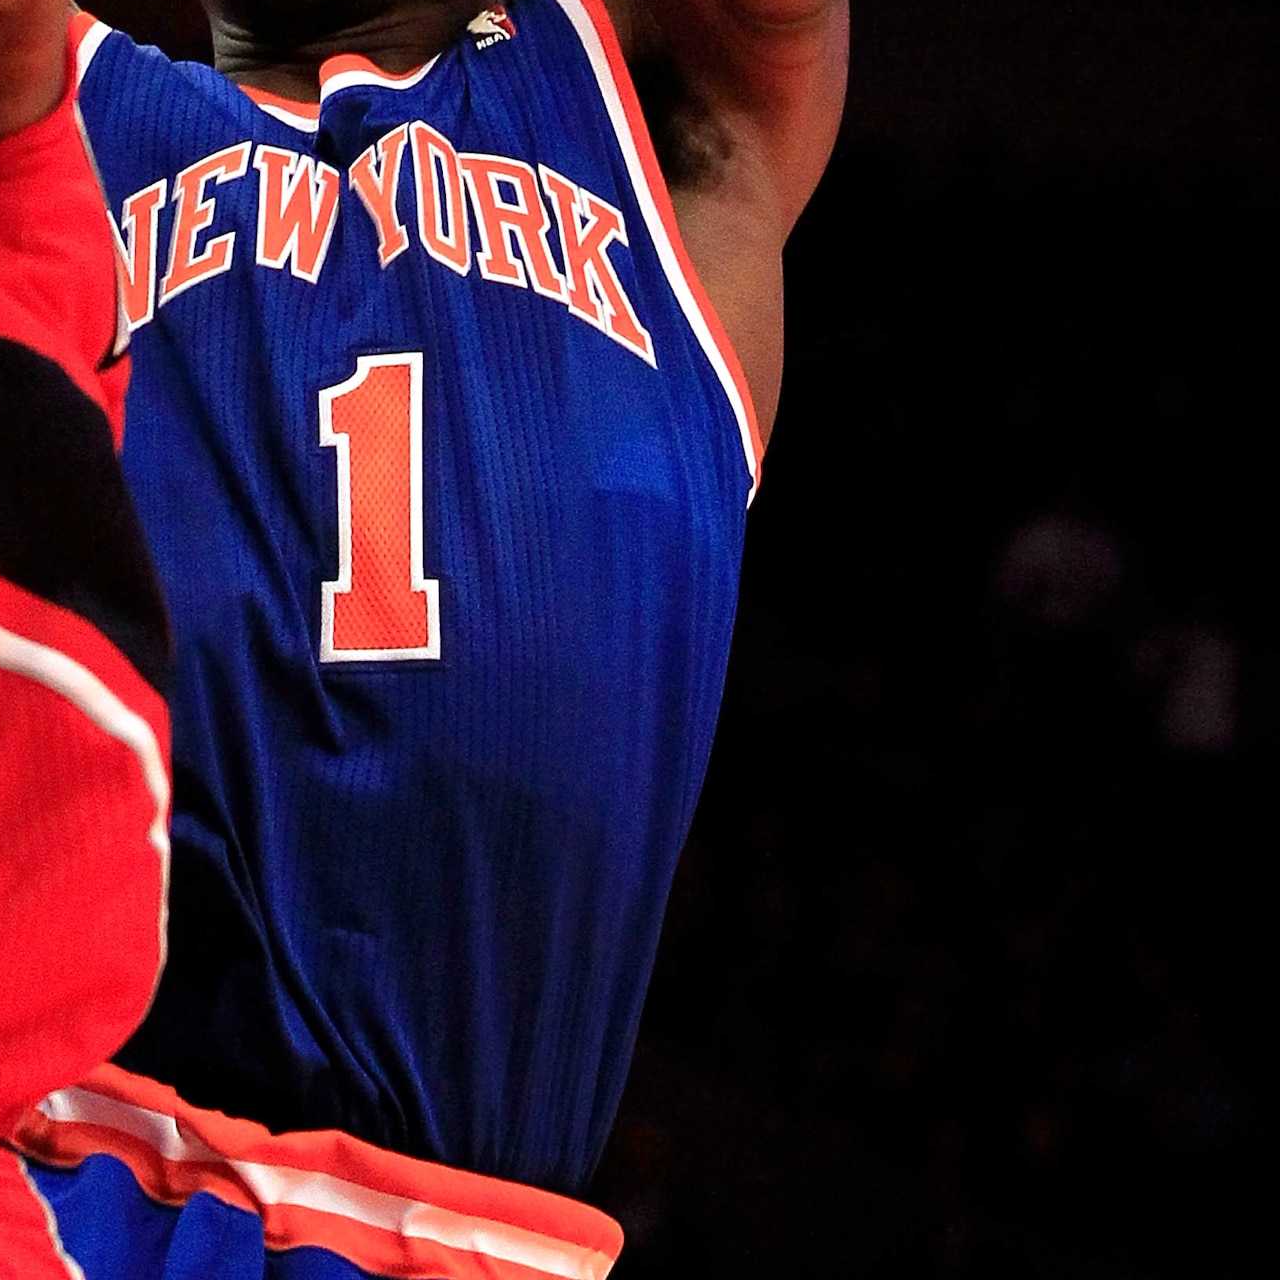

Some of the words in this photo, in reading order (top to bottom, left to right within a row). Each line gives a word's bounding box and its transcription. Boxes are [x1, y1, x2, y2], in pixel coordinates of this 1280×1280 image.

[475, 32, 504, 51] NBA
[111, 140, 341, 332] NEW
[348, 120, 658, 369] YORK
[319, 351, 441, 662] 1
